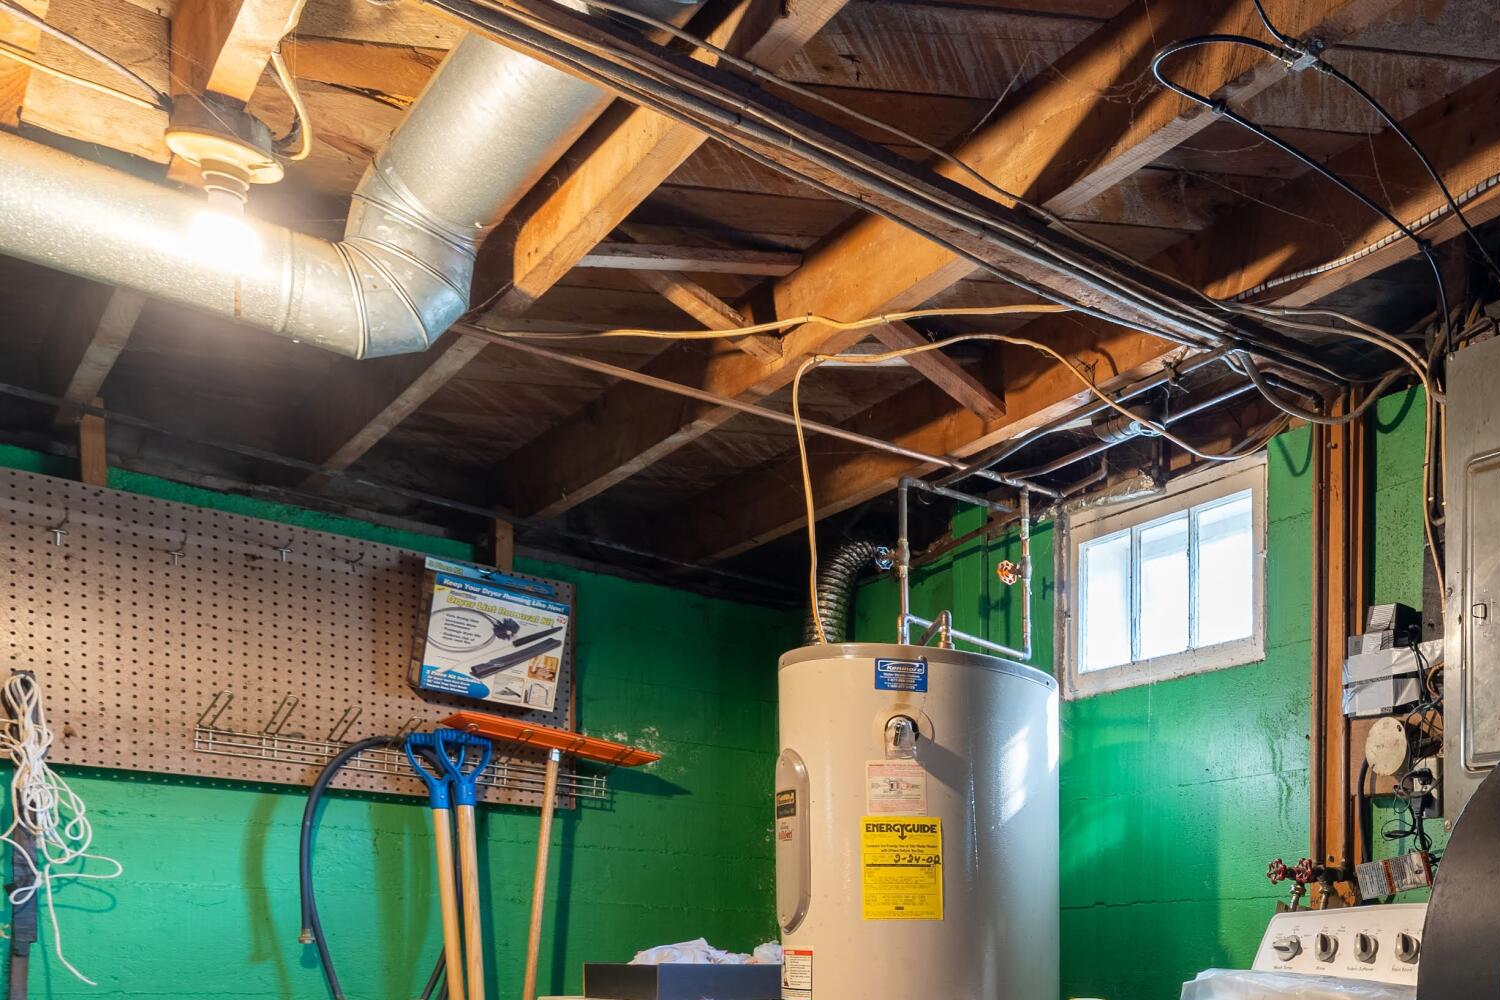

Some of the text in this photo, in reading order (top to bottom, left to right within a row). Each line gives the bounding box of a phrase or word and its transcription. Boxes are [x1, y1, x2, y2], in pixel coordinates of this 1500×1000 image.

[443, 578, 464, 590] Keep
[464, 583, 481, 593] Your
[482, 587, 503, 599] Dryer
[447, 595, 476, 609] Dryer
[476, 601, 498, 614] Lint
[498, 605, 539, 625] Removal
[886, 665, 923, 673] Kenmore
[865, 823, 937, 835] ENERGYGUIDE
